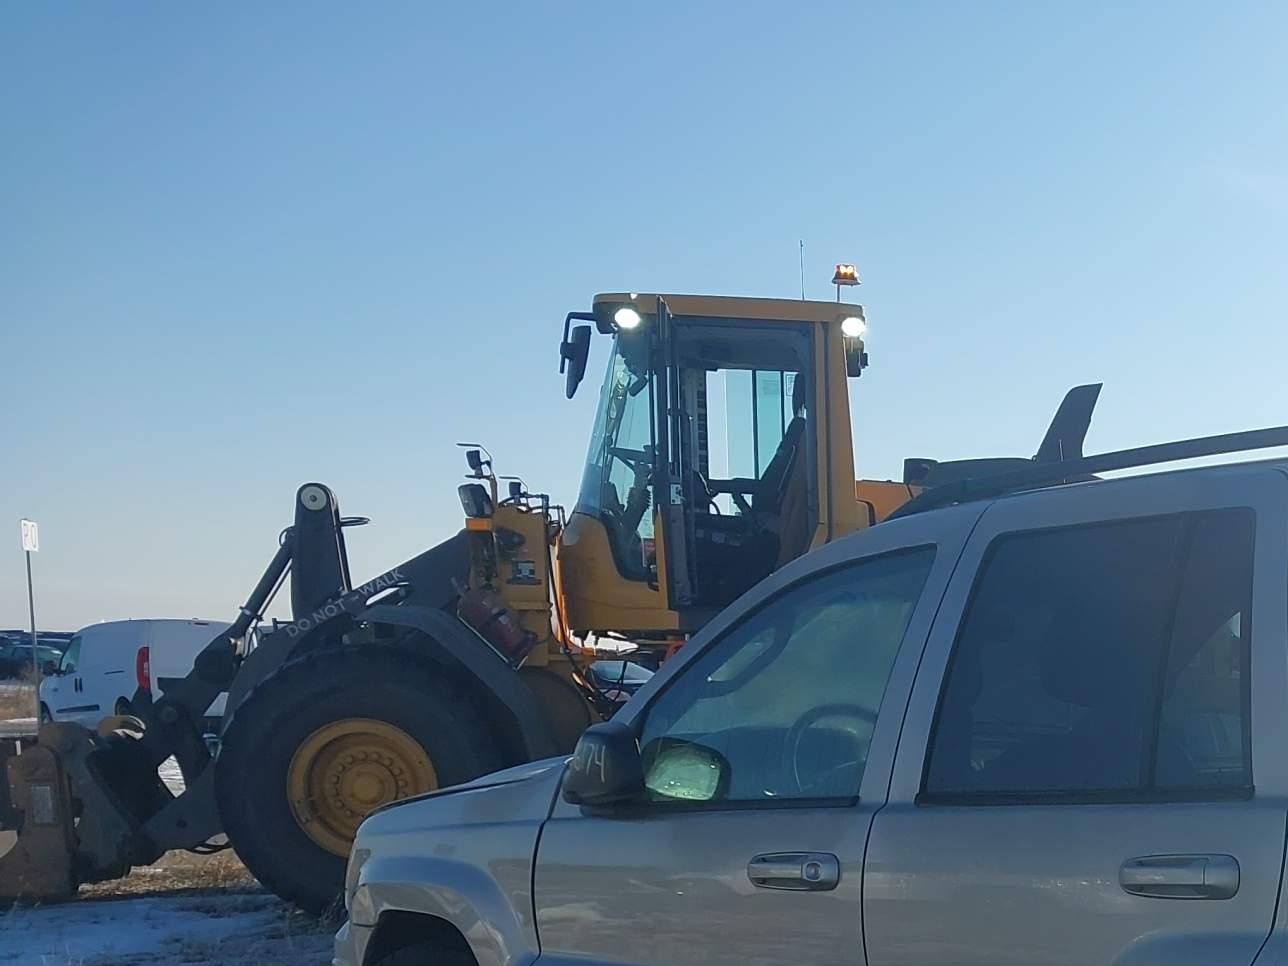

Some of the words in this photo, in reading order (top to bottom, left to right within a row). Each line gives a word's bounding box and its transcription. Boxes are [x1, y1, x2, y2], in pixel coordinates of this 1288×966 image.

[286, 618, 311, 638] DO
[312, 598, 346, 623] NOT
[359, 568, 404, 596] WALK
